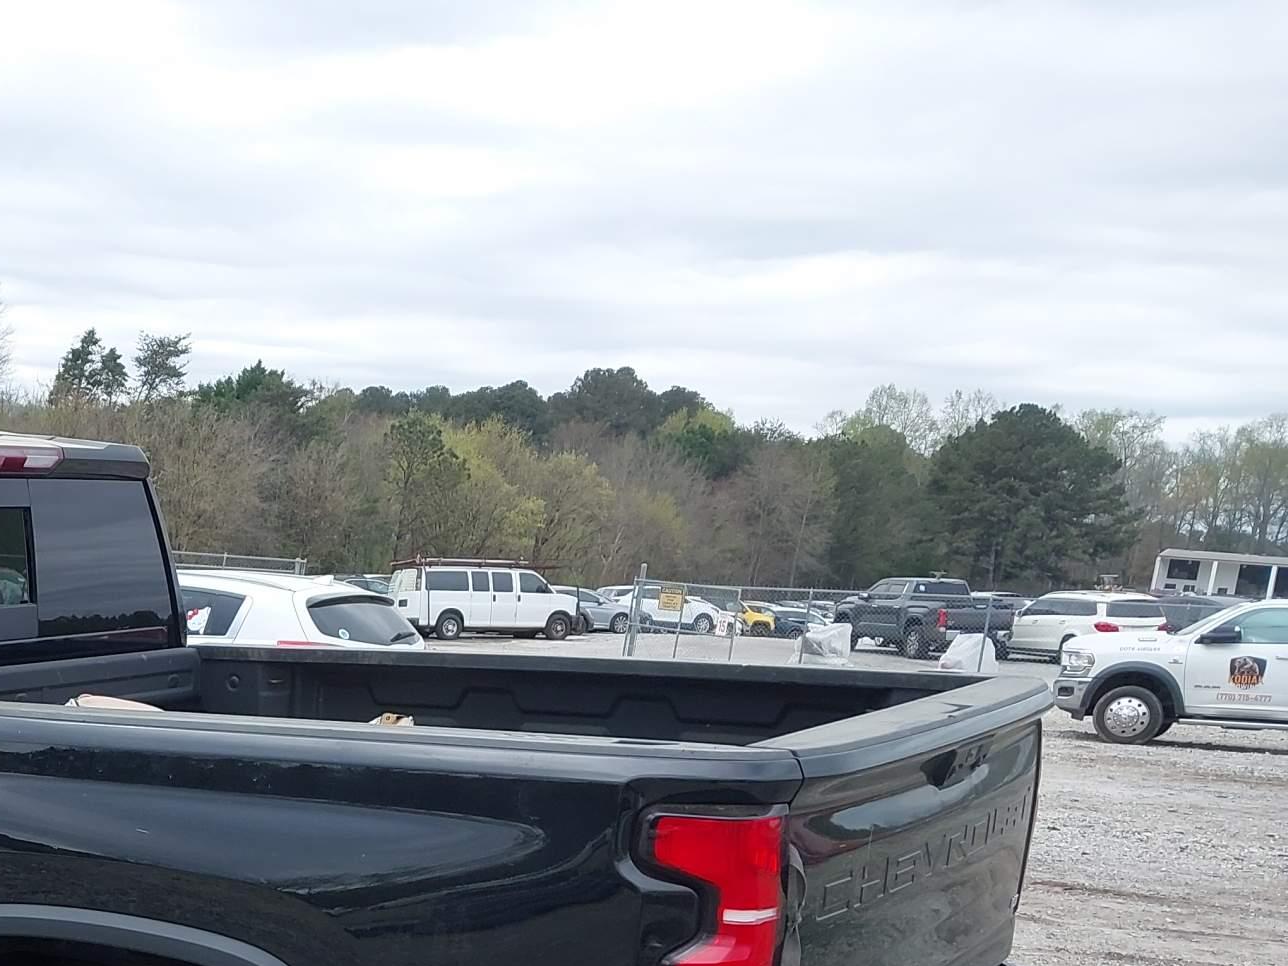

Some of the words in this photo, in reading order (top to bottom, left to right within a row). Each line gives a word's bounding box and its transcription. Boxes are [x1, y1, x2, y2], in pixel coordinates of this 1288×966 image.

[718, 619, 726, 633] 15
[1228, 674, 1264, 685] KODIAK
[815, 786, 1033, 921] CHEVROLET
